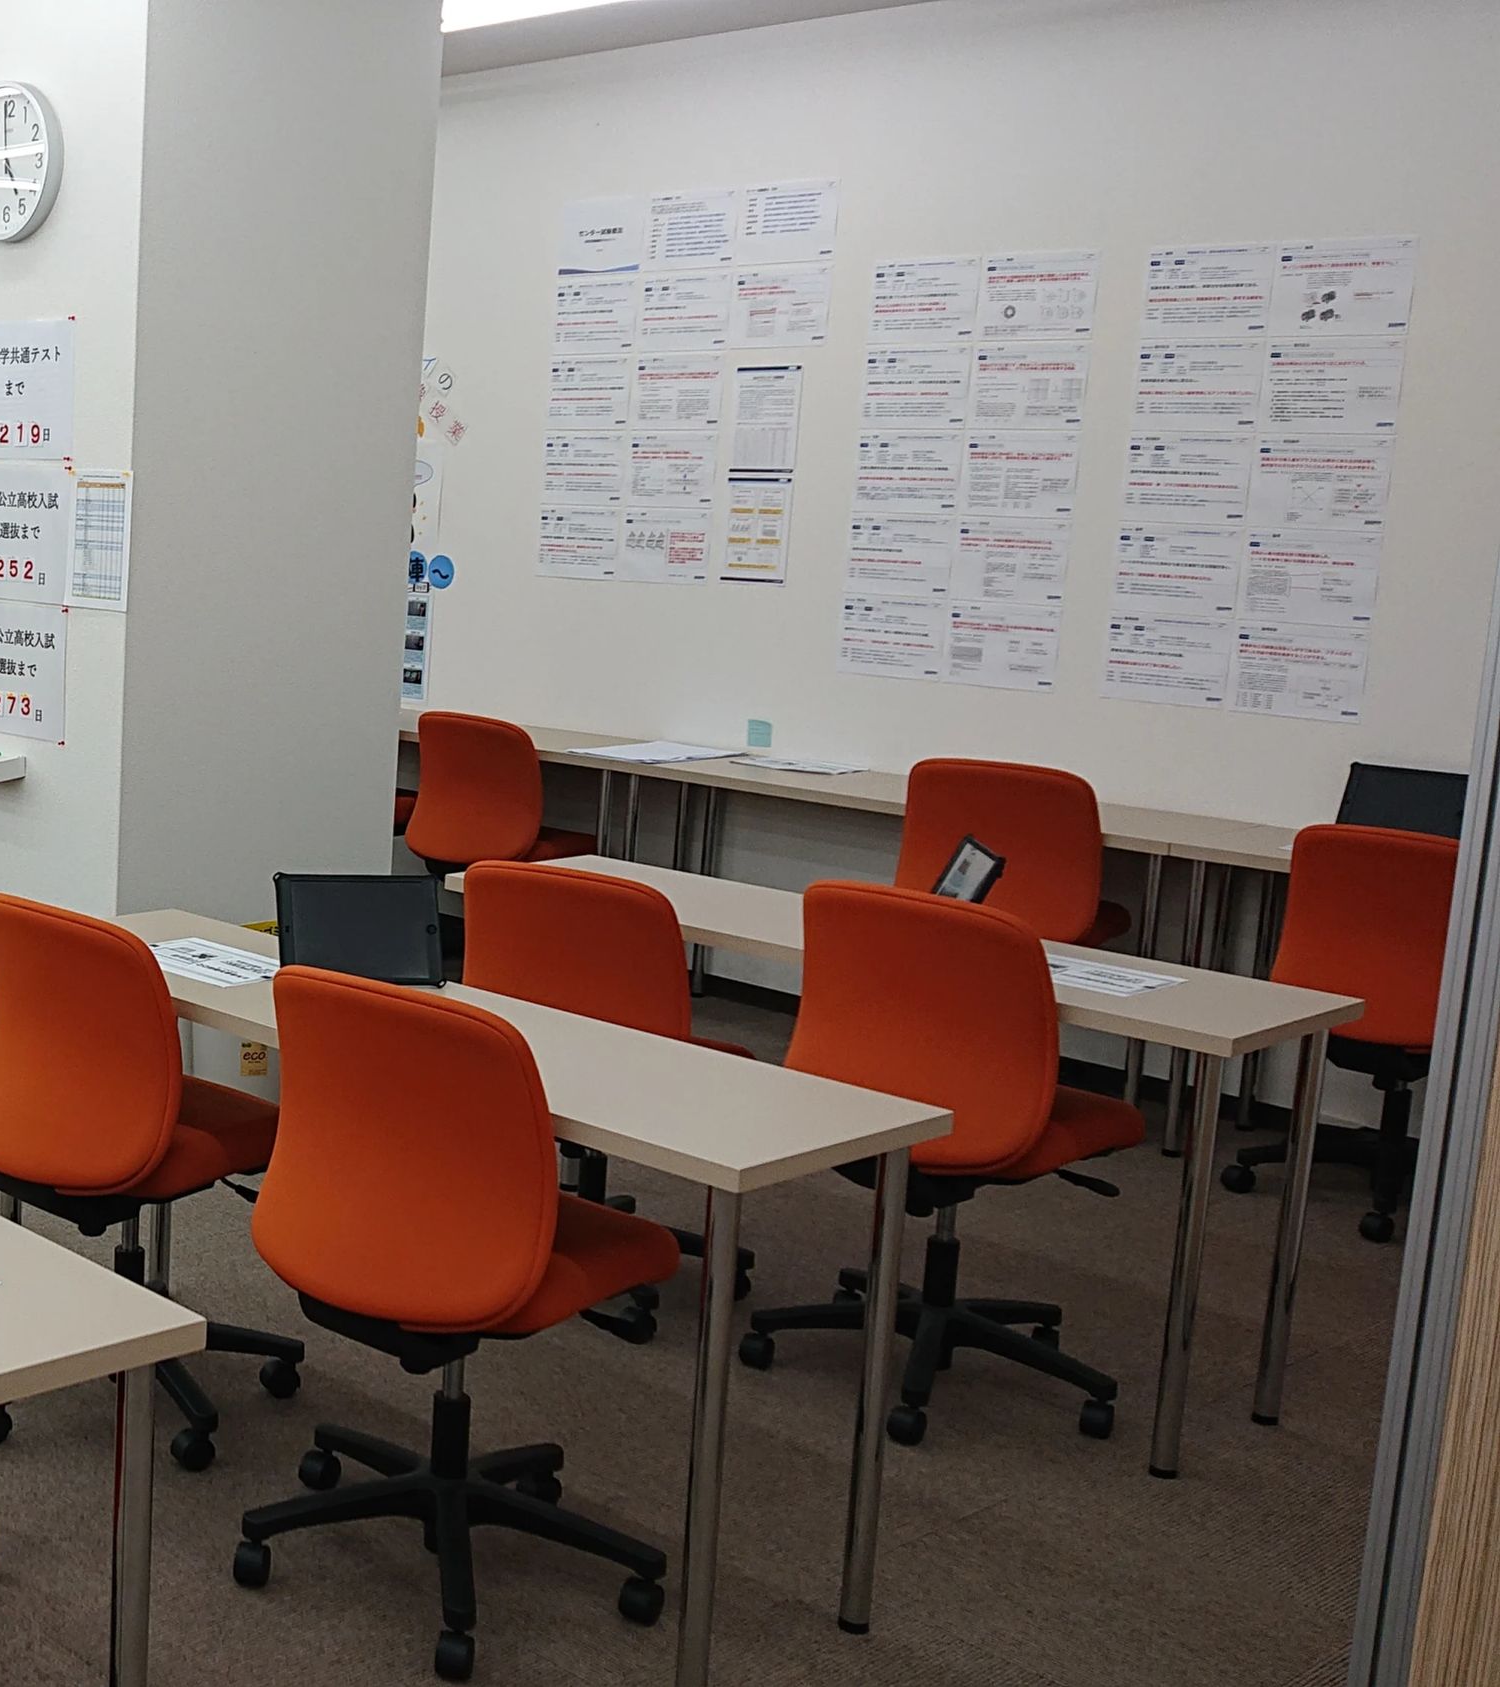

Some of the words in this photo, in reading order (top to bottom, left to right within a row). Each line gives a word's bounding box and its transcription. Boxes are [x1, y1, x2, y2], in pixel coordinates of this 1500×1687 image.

[31, 123, 41, 142] 2
[35, 151, 43, 169] 3
[2, 205, 11, 224] 6
[18, 197, 27, 216] 5
[5, 380, 25, 396] まで
[243, 1051, 266, 1061] eco
